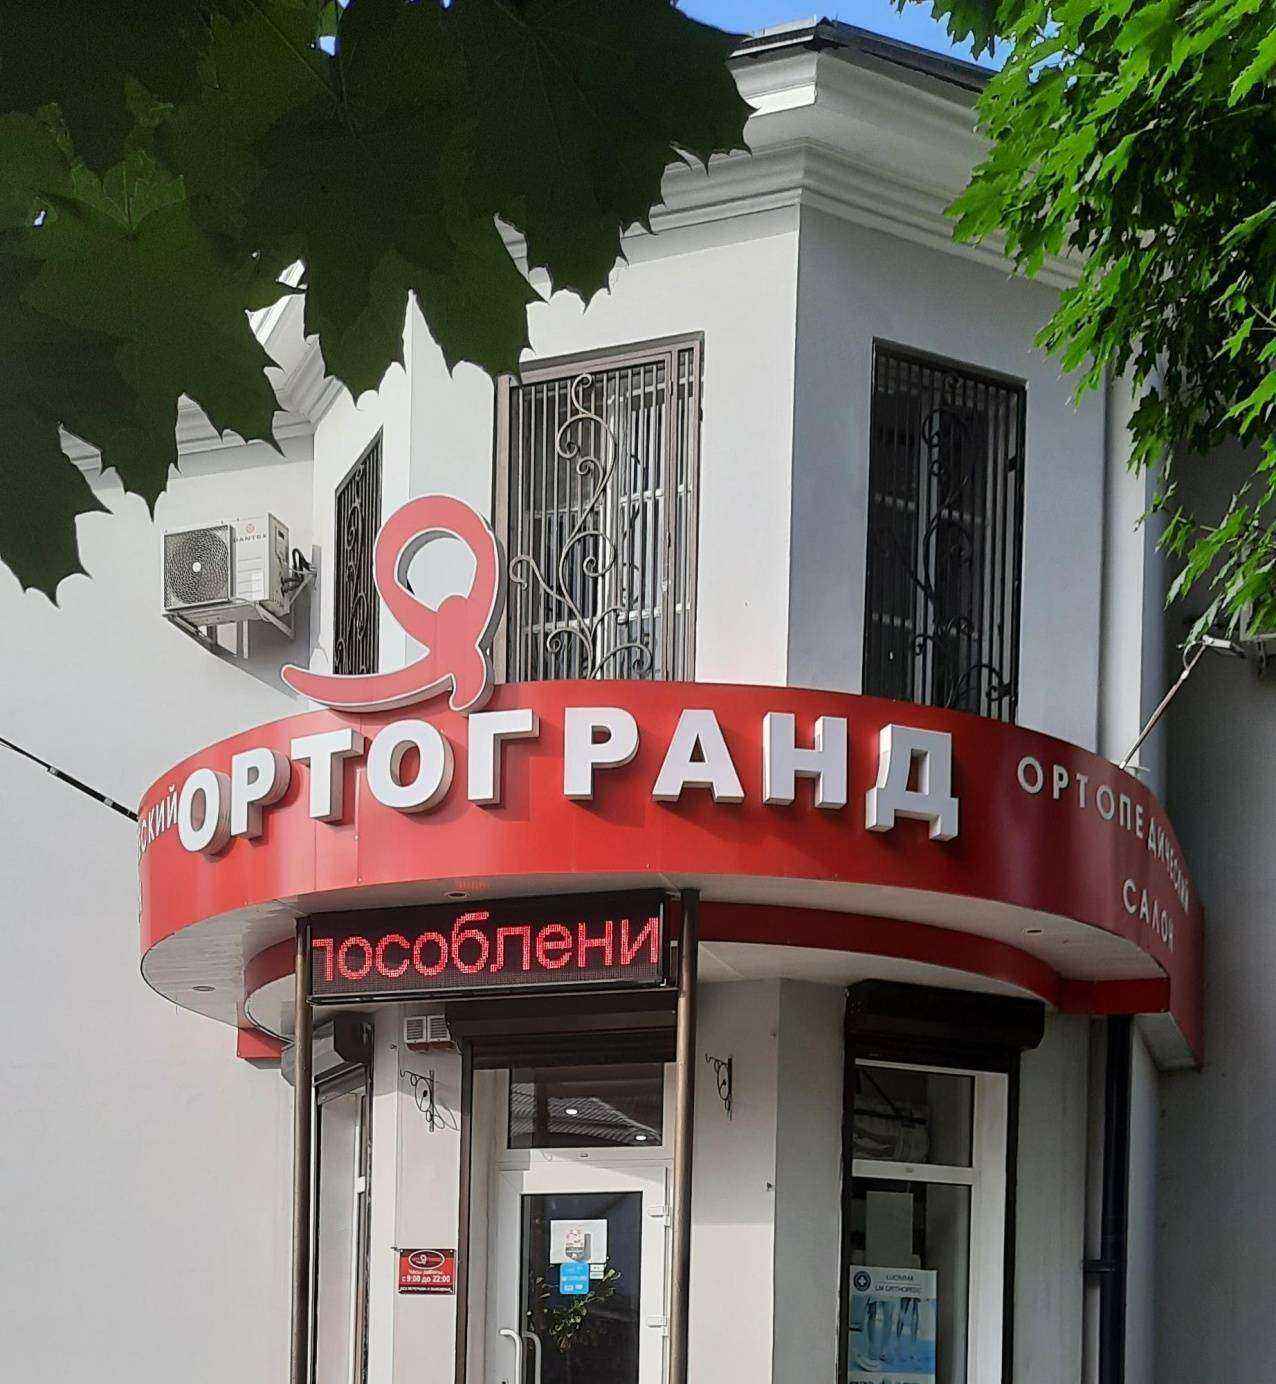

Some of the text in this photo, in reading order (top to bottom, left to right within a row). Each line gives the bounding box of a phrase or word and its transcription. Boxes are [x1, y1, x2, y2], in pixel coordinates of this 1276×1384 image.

[177, 706, 962, 854] ОРТОГРАНД
[138, 783, 177, 858] СКИЙ
[1123, 878, 1174, 953] САЛОН
